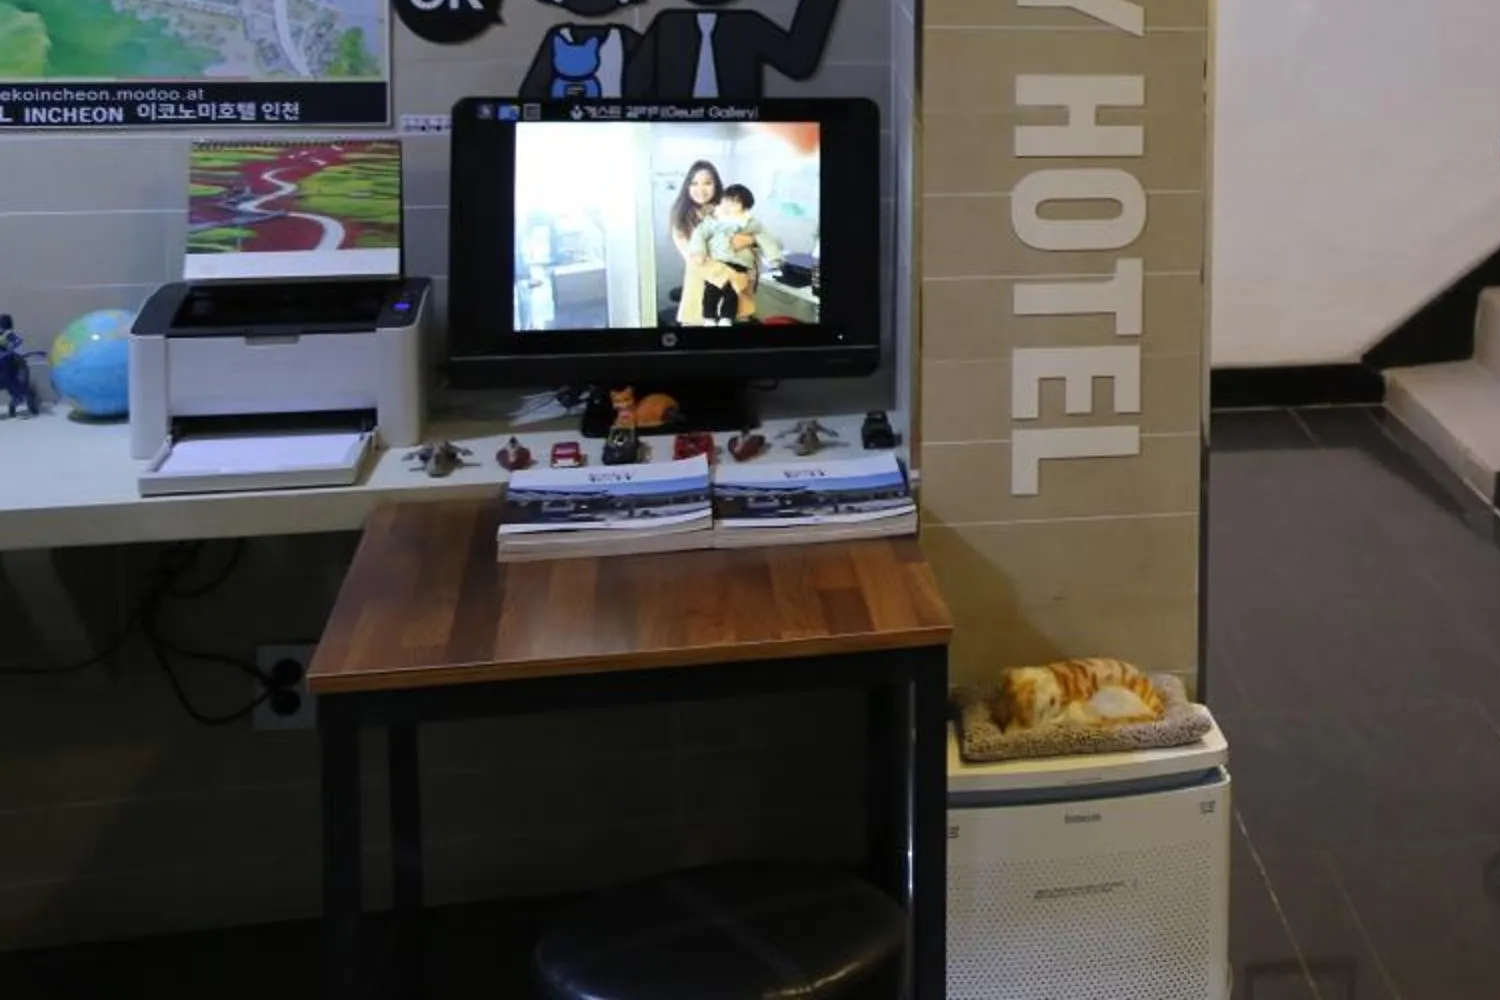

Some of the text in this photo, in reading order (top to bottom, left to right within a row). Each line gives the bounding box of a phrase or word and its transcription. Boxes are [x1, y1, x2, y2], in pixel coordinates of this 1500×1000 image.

[24, 107, 124, 124] INCHEON
[137, 103, 257, 121] 이코노미호텔
[263, 103, 300, 122] 인천
[1010, 74, 1147, 495] HOTEL
